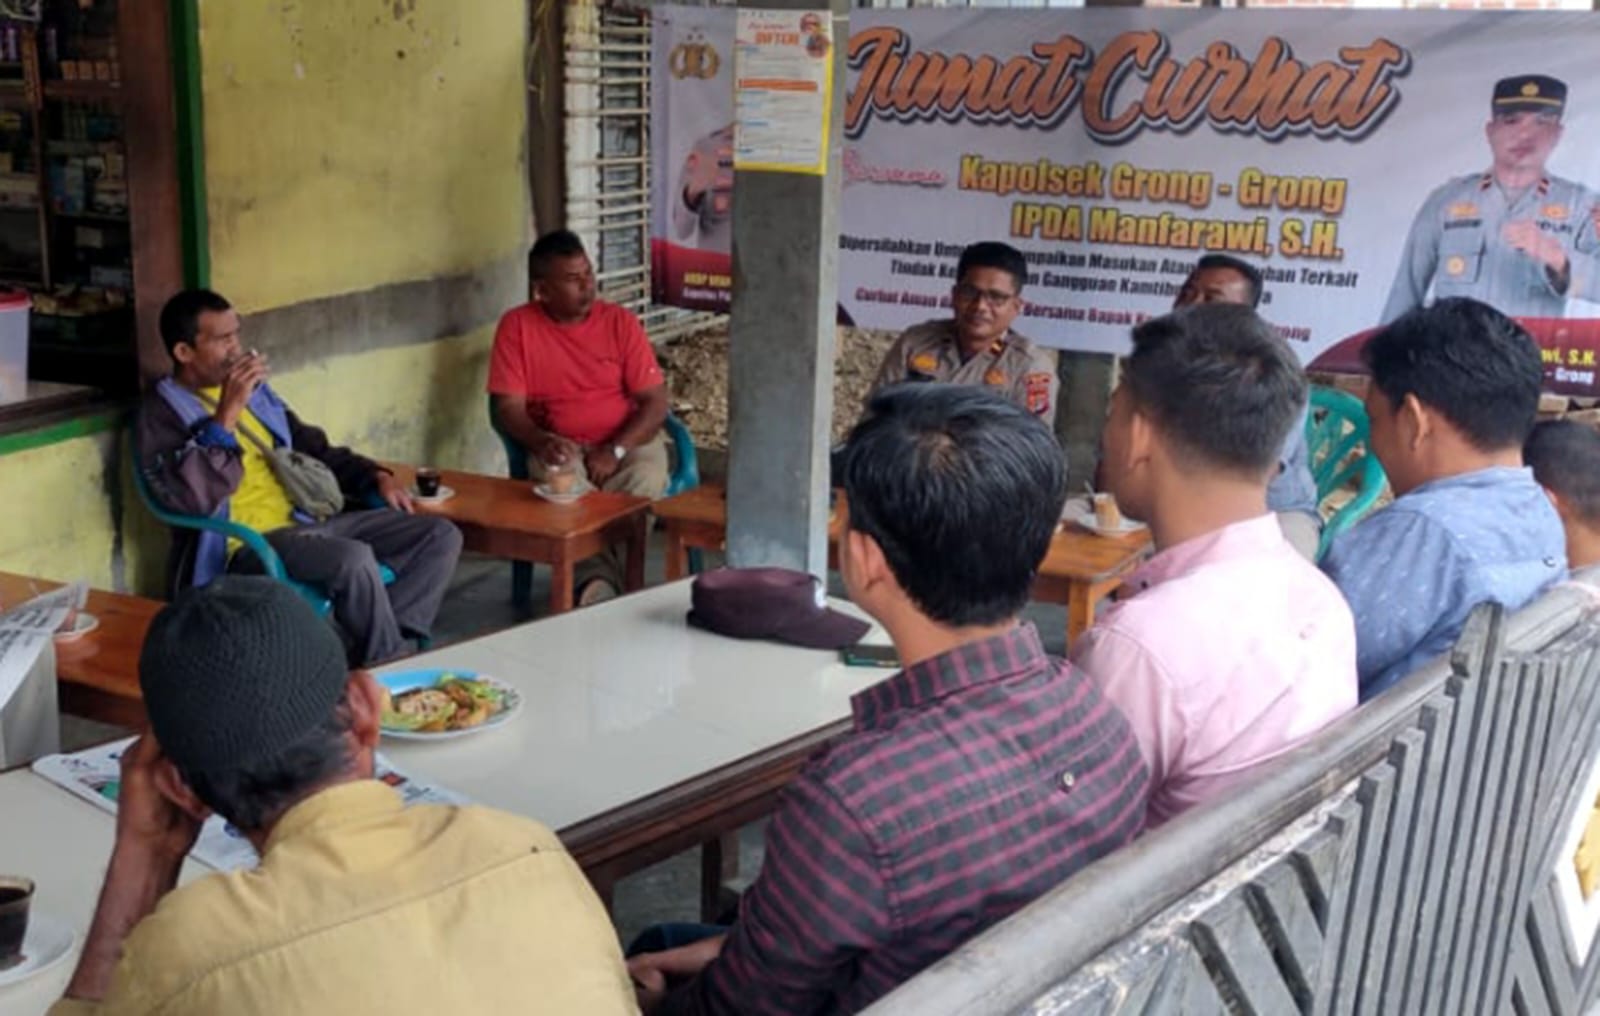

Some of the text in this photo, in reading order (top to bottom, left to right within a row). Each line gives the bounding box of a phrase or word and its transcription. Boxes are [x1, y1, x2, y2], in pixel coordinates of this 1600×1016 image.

[844, 27, 1410, 146] Jumat Curhat
[959, 155, 1348, 218] Kapolsek Grong - Grong
[1011, 202, 1345, 260] IPDA Manfarawi, S.H.
[891, 259, 936, 277] Tindak
[1043, 271, 1117, 292] Gangguan
[1120, 277, 1179, 297] Kamtib
[1023, 250, 1086, 269] mpaikan
[1089, 253, 1158, 273] Masukan
[1255, 265, 1296, 284] uhan
[1300, 267, 1359, 288] Terkait
[901, 291, 938, 308] Aman
[1023, 303, 1085, 320] Bersama
[1088, 307, 1133, 325] Bapak
[1274, 323, 1312, 342] rong
